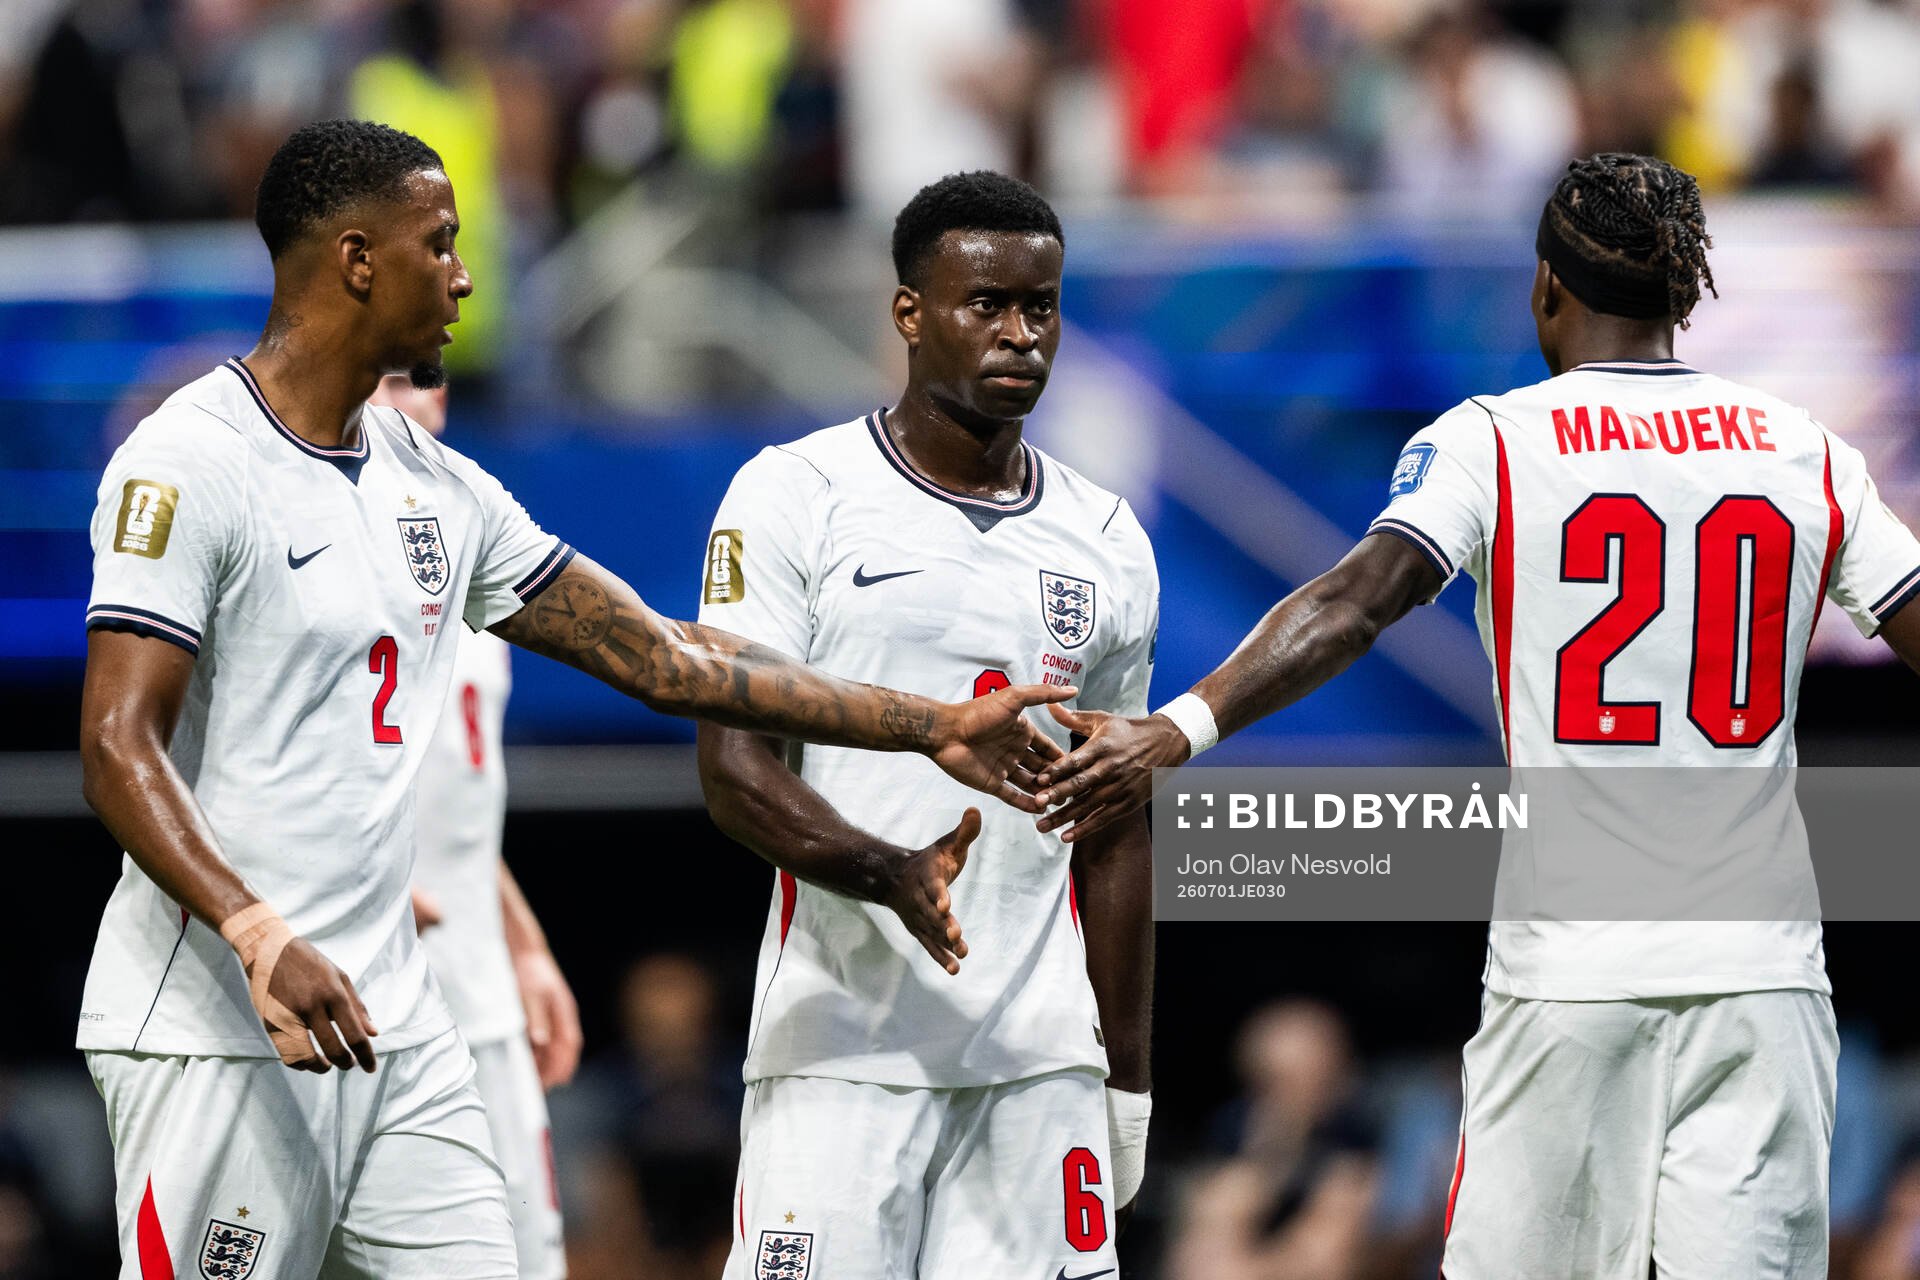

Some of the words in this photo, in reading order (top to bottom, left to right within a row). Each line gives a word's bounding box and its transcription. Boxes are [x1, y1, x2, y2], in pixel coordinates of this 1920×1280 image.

[1552, 405, 1777, 455] MADUEKE
[421, 603, 442, 616] CONGO
[1554, 492, 1795, 749] 20
[368, 636, 404, 745] 2
[1042, 653, 1072, 672] CONGO
[1062, 1147, 1107, 1252] 6
